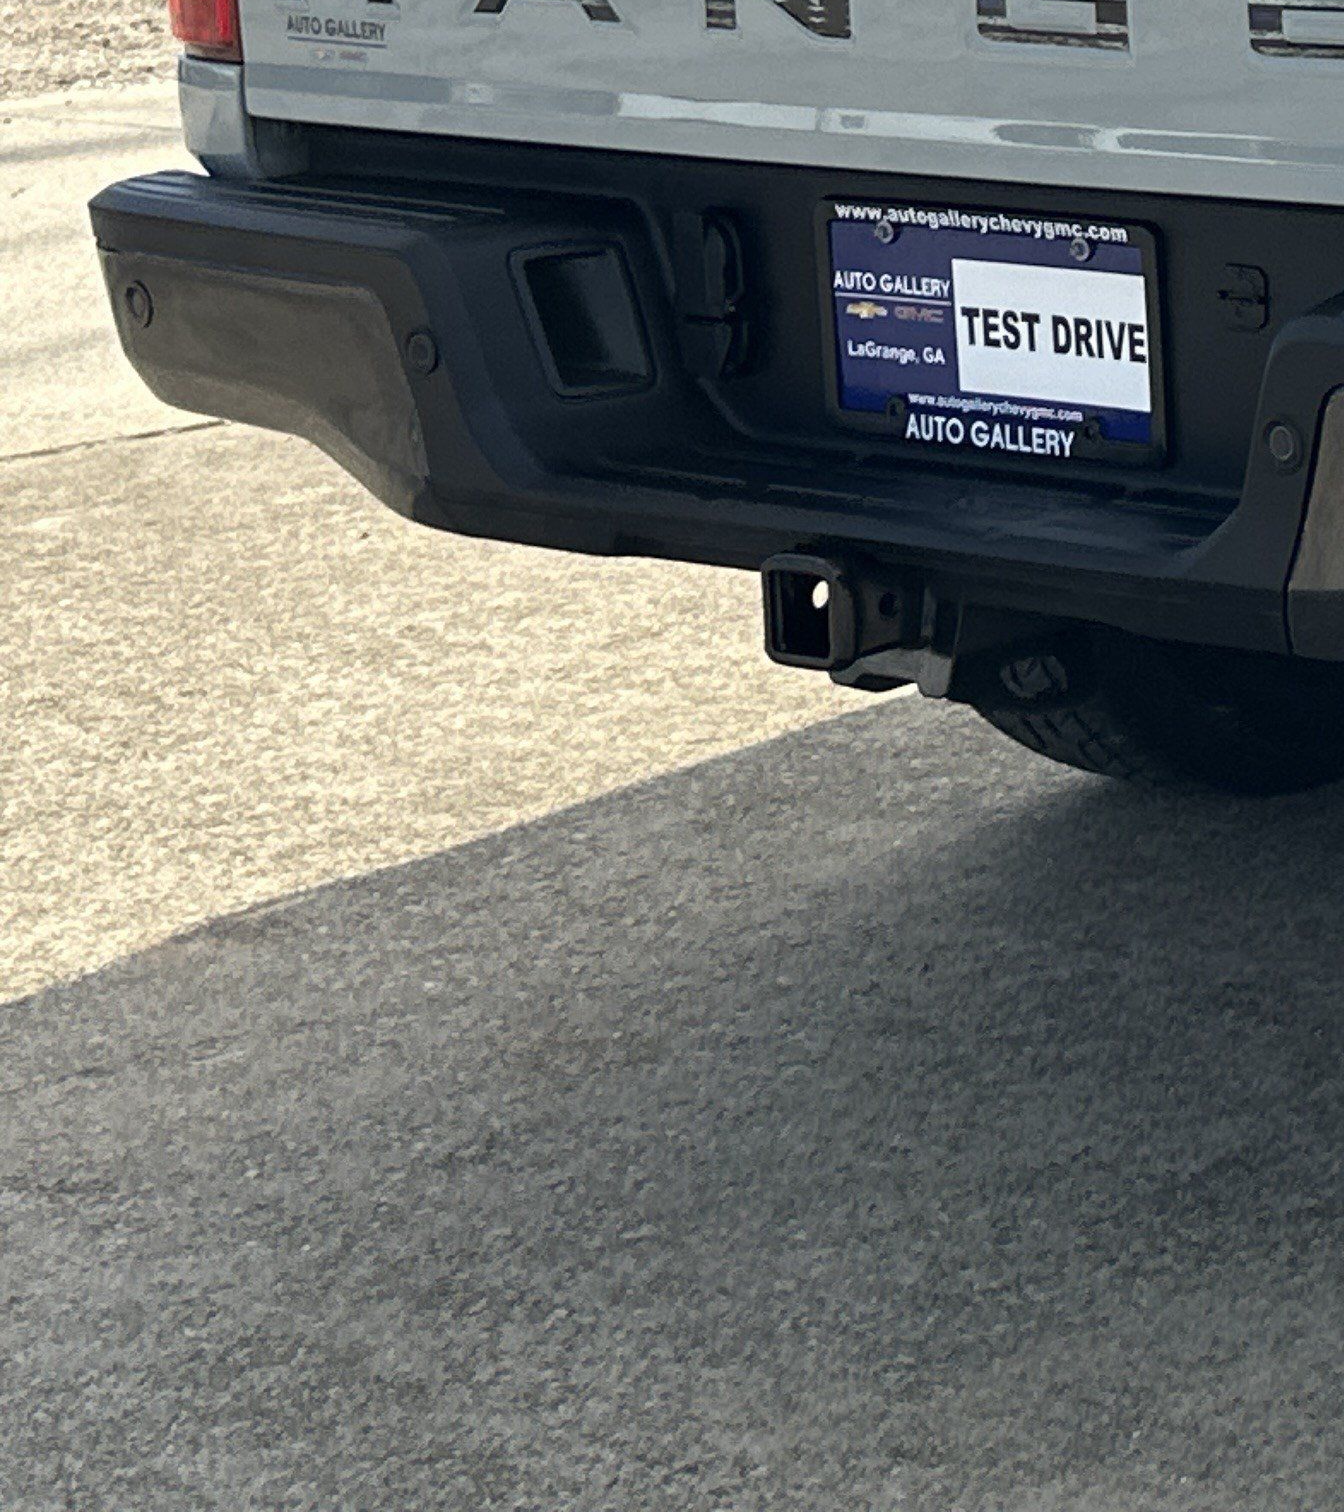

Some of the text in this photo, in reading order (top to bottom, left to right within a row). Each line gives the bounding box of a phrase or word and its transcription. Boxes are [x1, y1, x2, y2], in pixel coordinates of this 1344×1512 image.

[286, 15, 386, 40] AUTO GALLERY
[834, 203, 1128, 243] www.autogallerychevygmc.com
[833, 270, 951, 298] AUTO GALLERY
[960, 306, 1147, 363] TEST DRIVE
[847, 339, 946, 365] LaGrange, GA
[905, 413, 1076, 458] AUTO GALLERY
